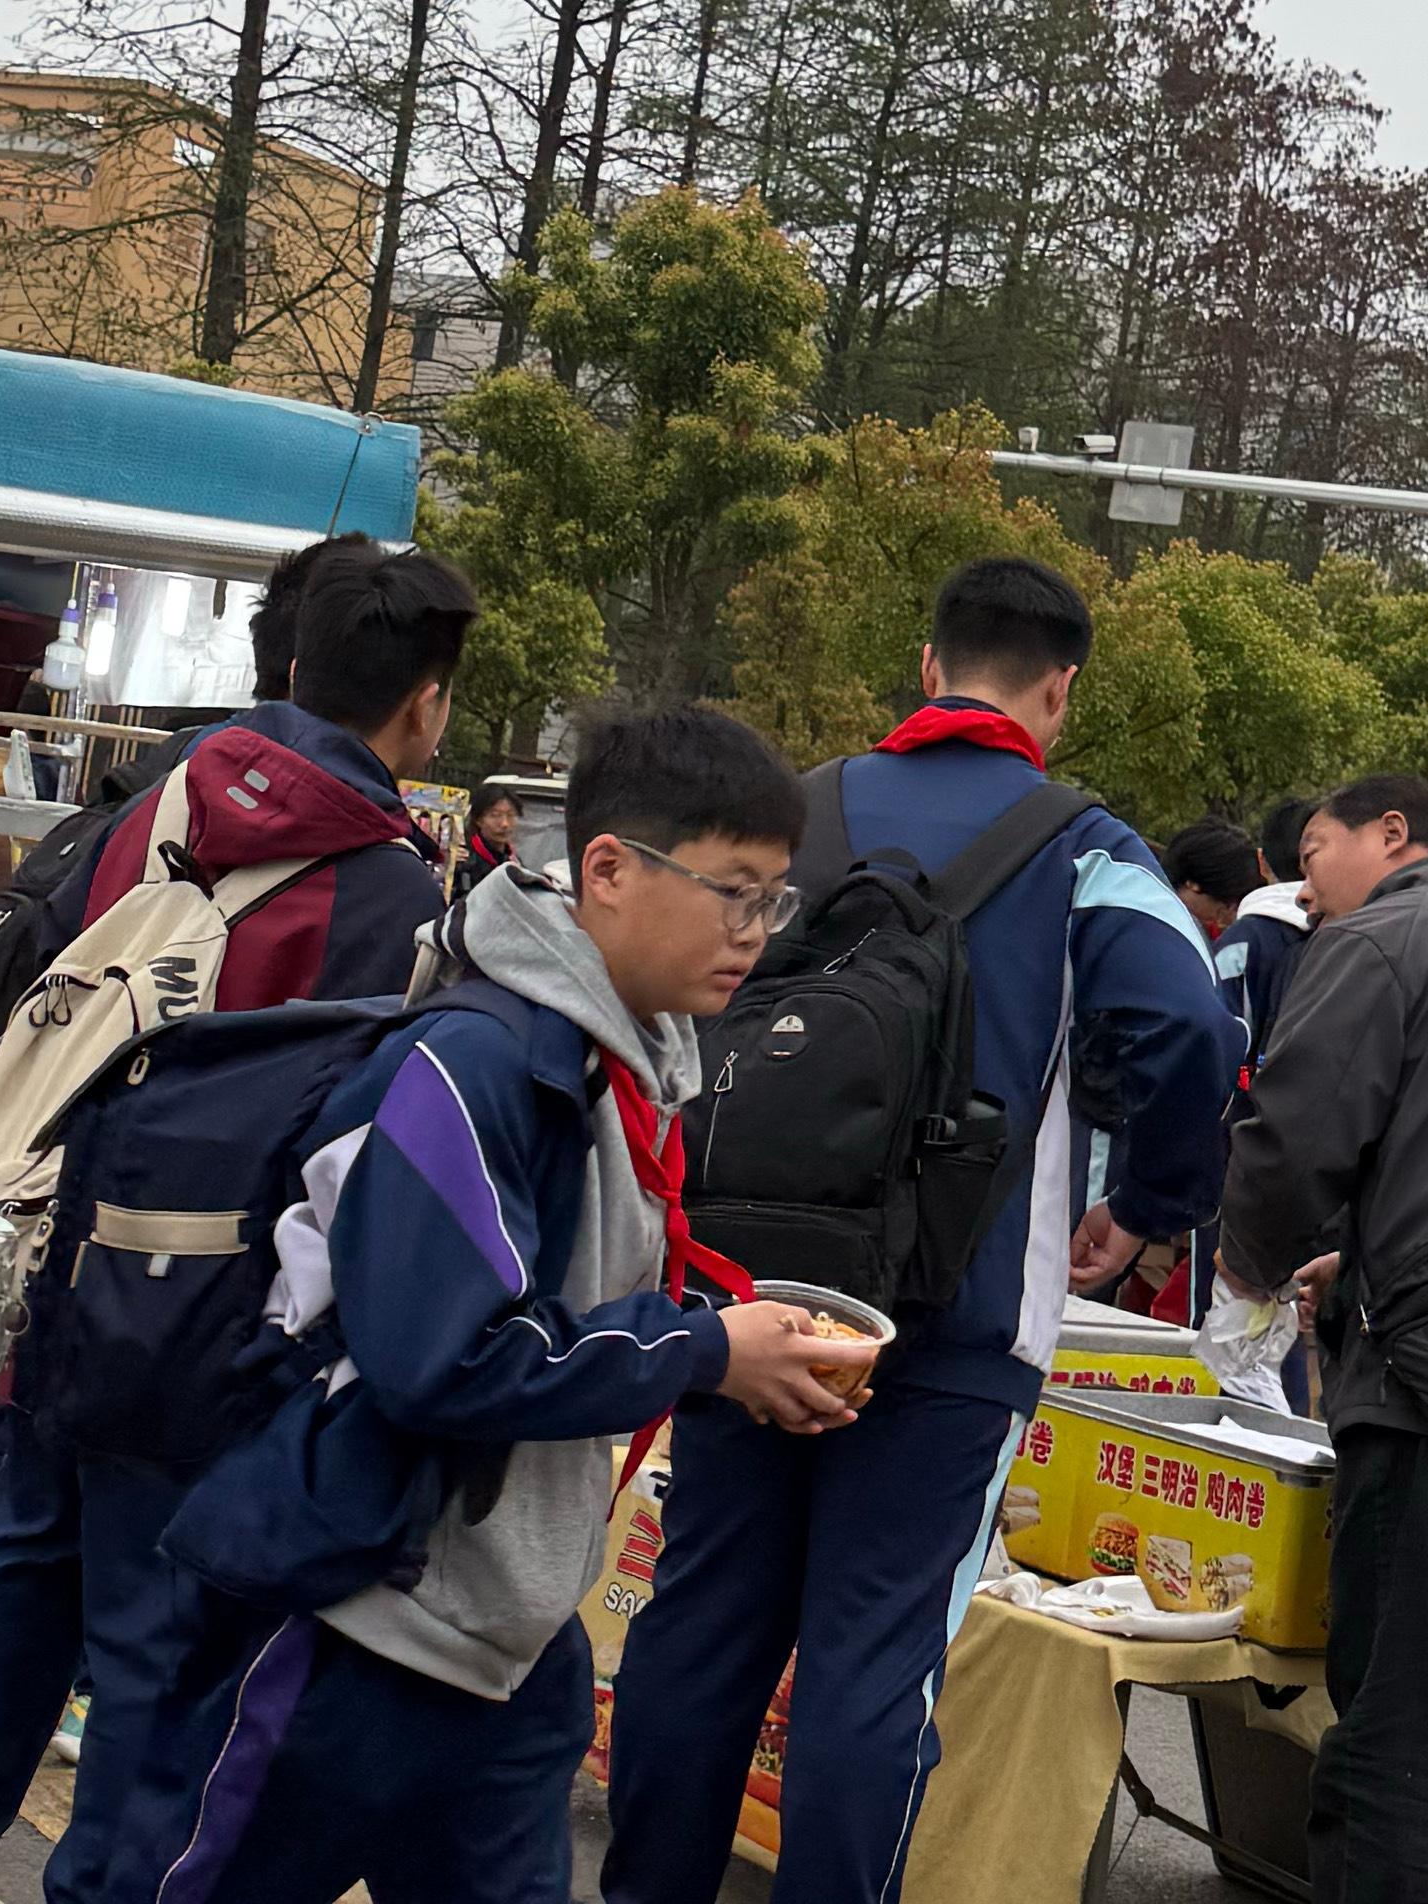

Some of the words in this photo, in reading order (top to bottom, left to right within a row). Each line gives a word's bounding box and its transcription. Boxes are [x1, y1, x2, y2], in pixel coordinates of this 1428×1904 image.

[1096, 1440, 1136, 1490] 汉堡
[1140, 1454, 1199, 1509] 三明治
[1204, 1471, 1267, 1529] 鸡肉卷
